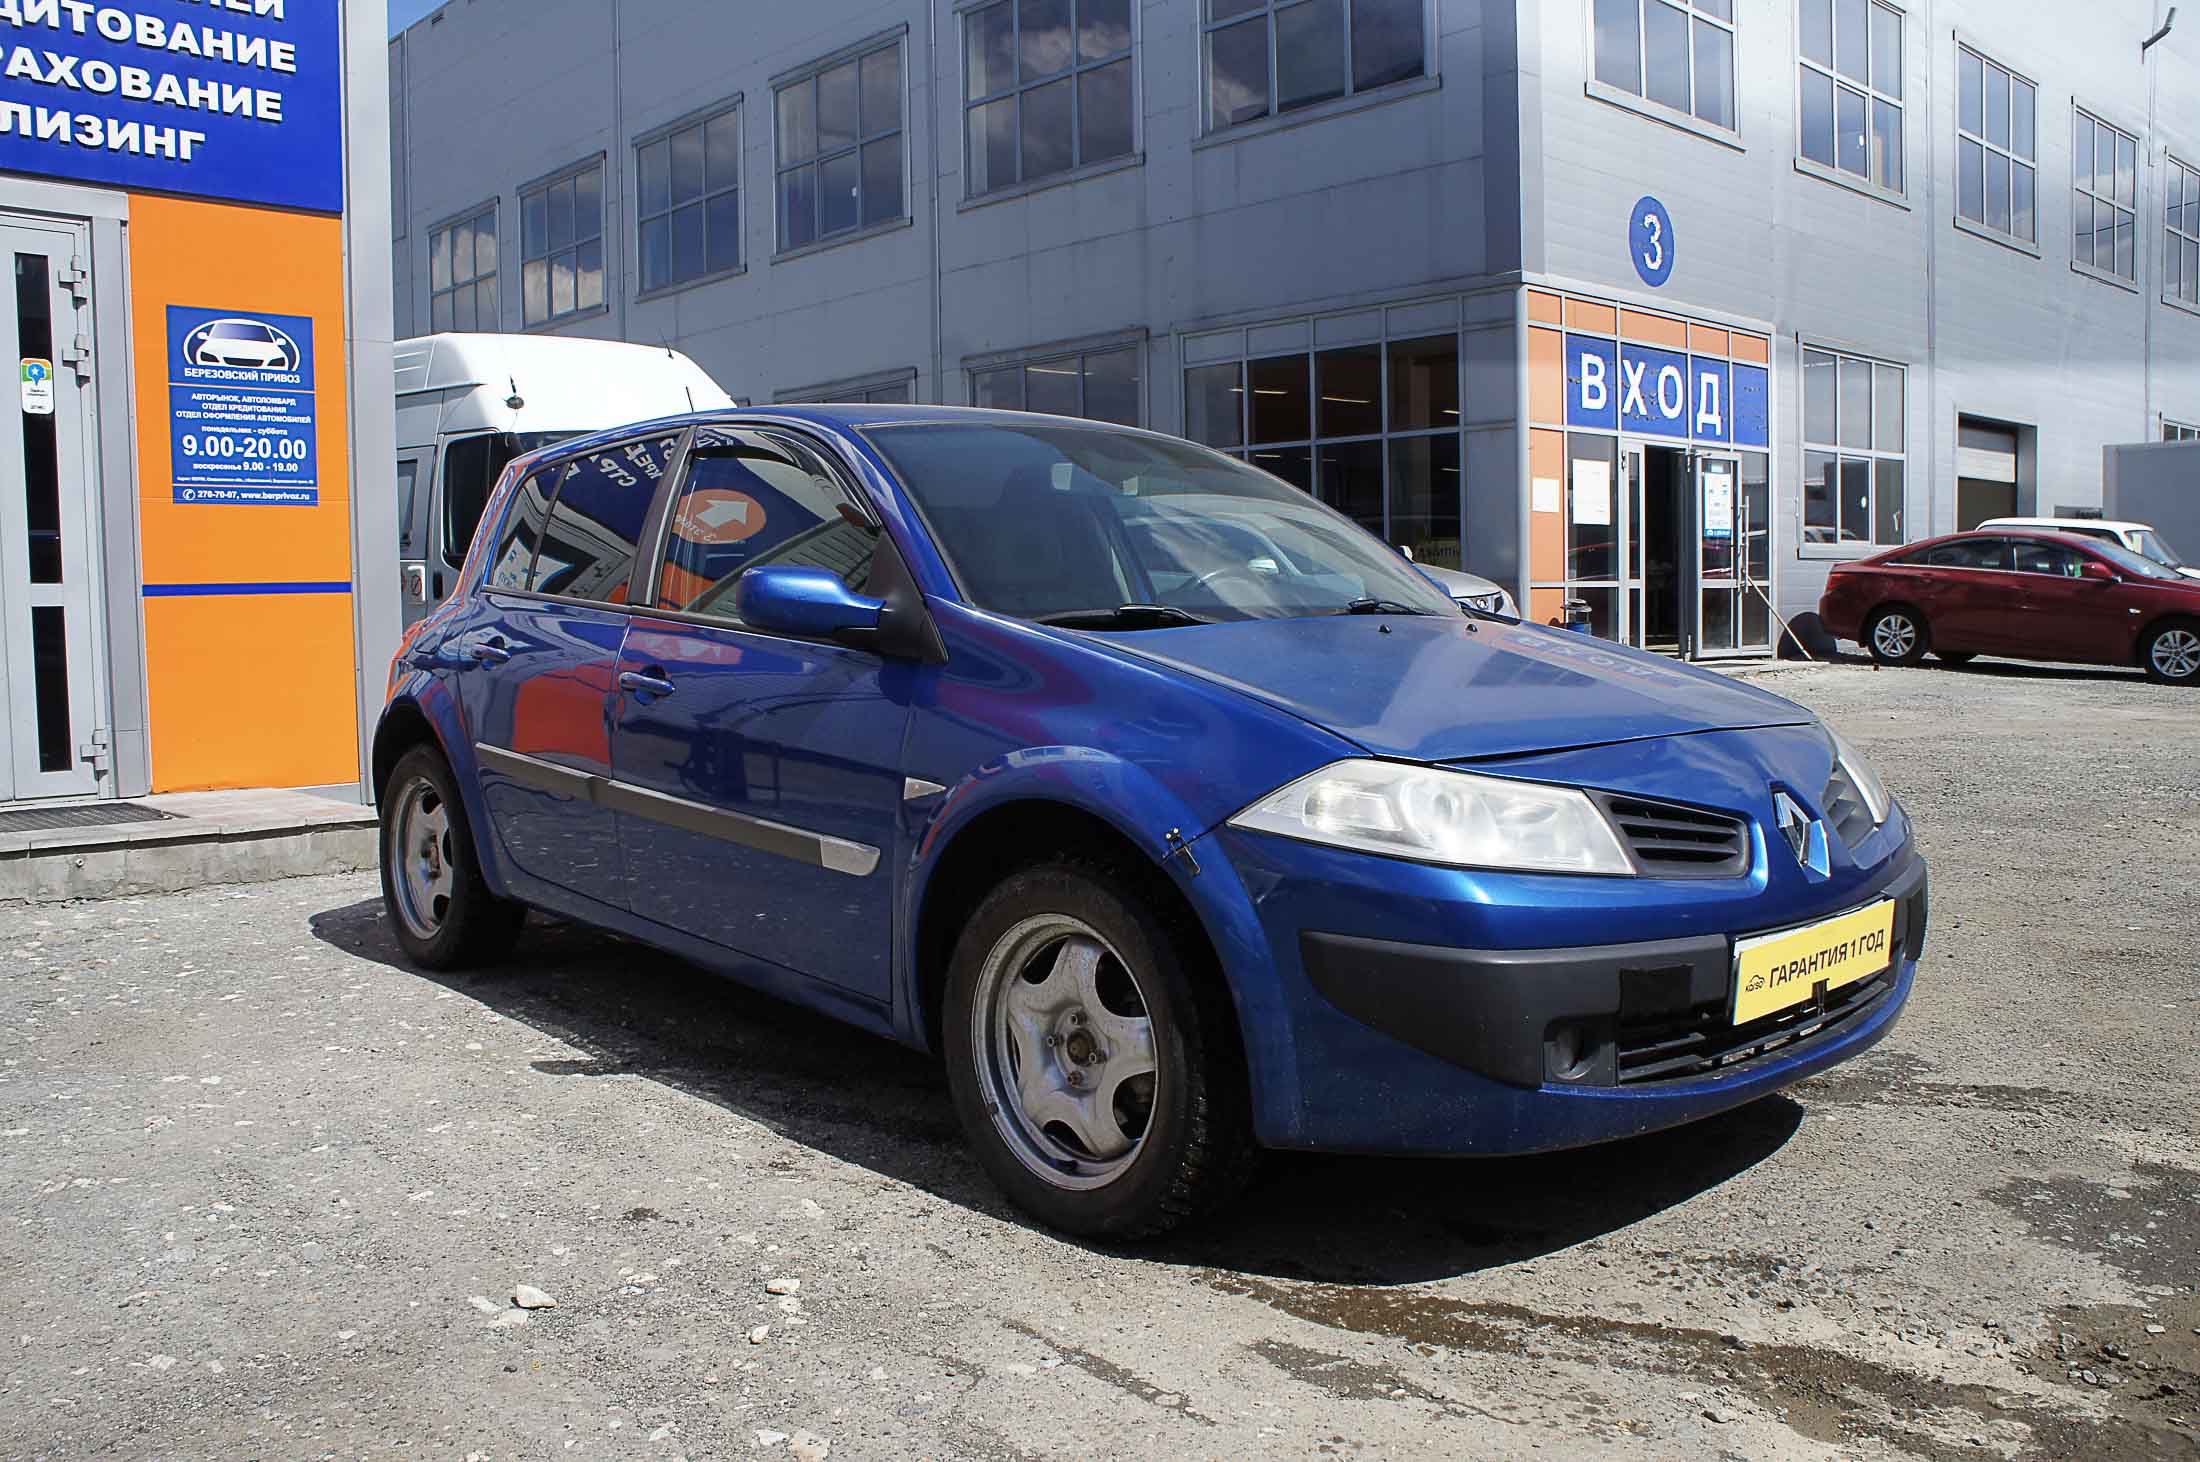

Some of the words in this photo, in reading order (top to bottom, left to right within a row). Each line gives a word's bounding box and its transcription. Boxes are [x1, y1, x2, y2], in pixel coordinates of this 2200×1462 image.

[0, 44, 283, 122] АХОВАНИЕ
[1642, 213, 1663, 271] 3
[184, 367, 259, 382] БЕРЕЗОВСКИЙ
[260, 373, 301, 385] ПРИВОЗ
[1580, 351, 1723, 437] ВХОД
[182, 434, 307, 460] 9.00-20.00
[242, 461, 264, 471] 9.00
[272, 462, 299, 473] 19.00
[1769, 942, 1848, 989] ГАРАНТИЯ
[1859, 928, 1886, 957] ГОД
